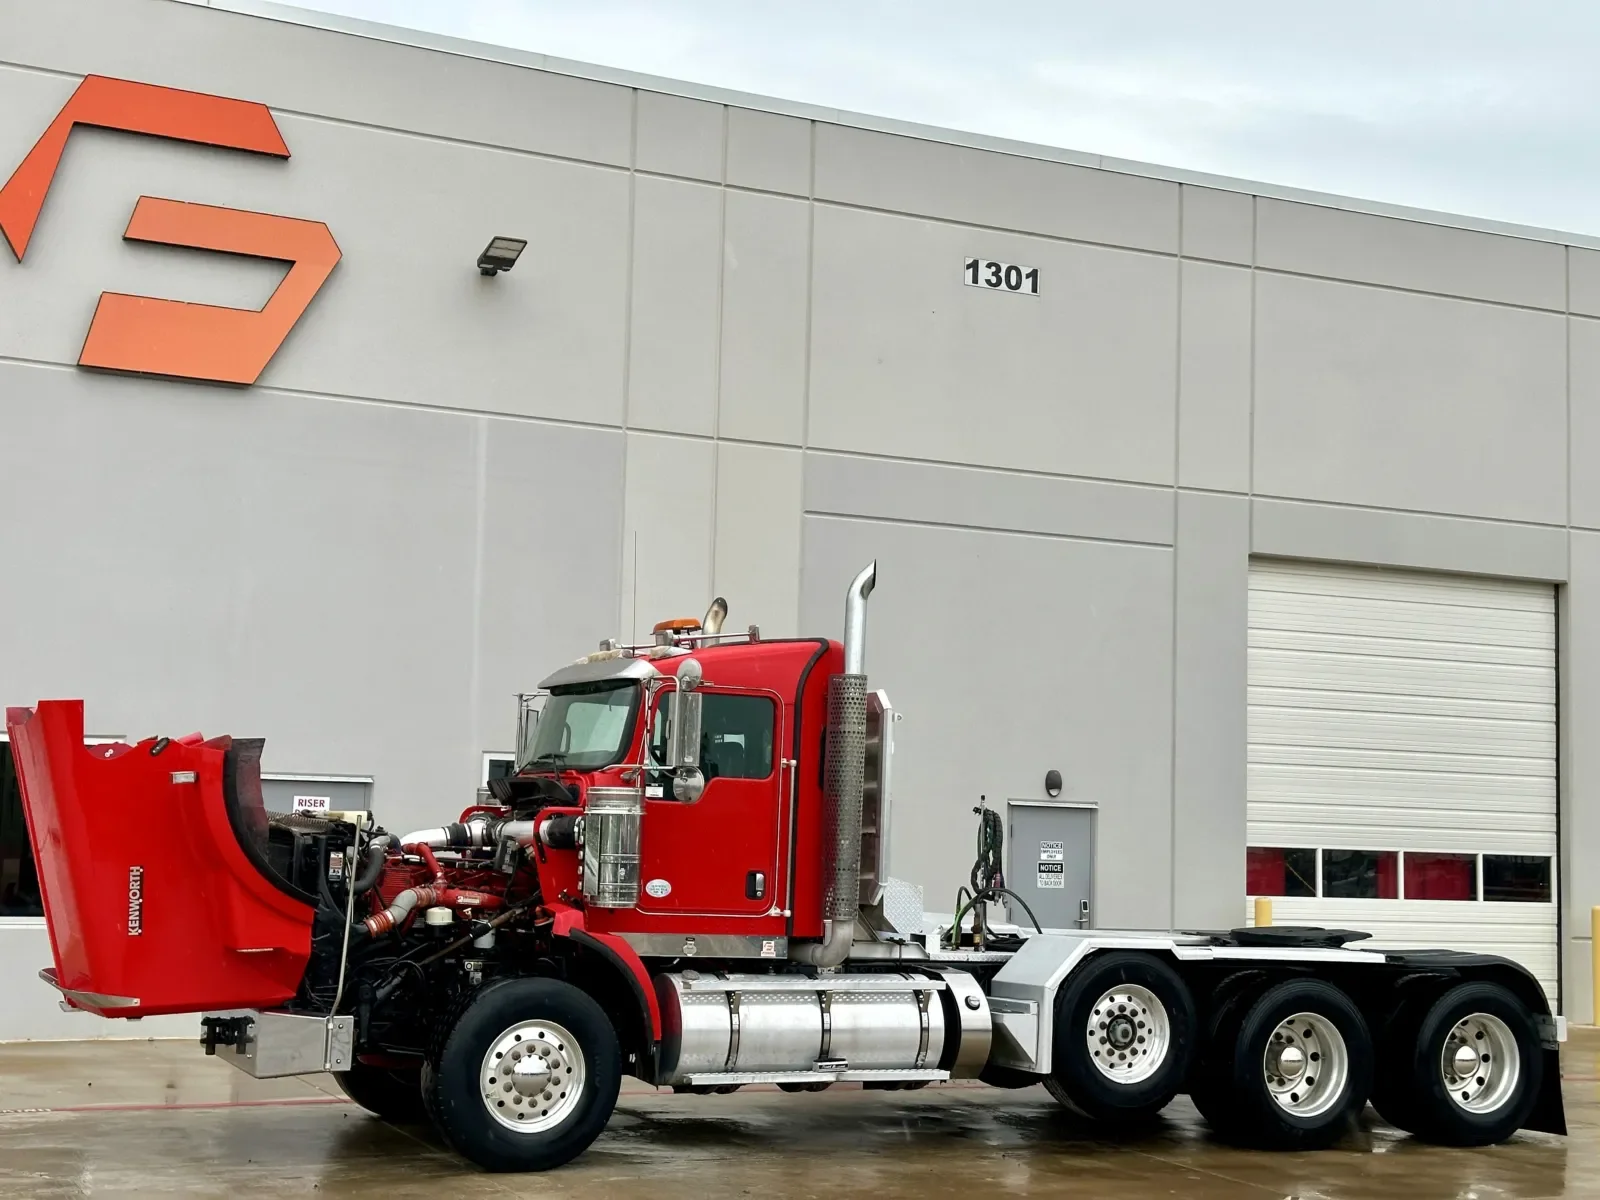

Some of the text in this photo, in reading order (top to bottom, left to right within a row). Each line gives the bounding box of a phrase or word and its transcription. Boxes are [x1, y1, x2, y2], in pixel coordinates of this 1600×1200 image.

[966, 259, 1039, 294] 1301
[298, 798, 325, 808] RISER
[1040, 864, 1062, 872] NOTICE
[128, 866, 141, 936] KENWORTH
